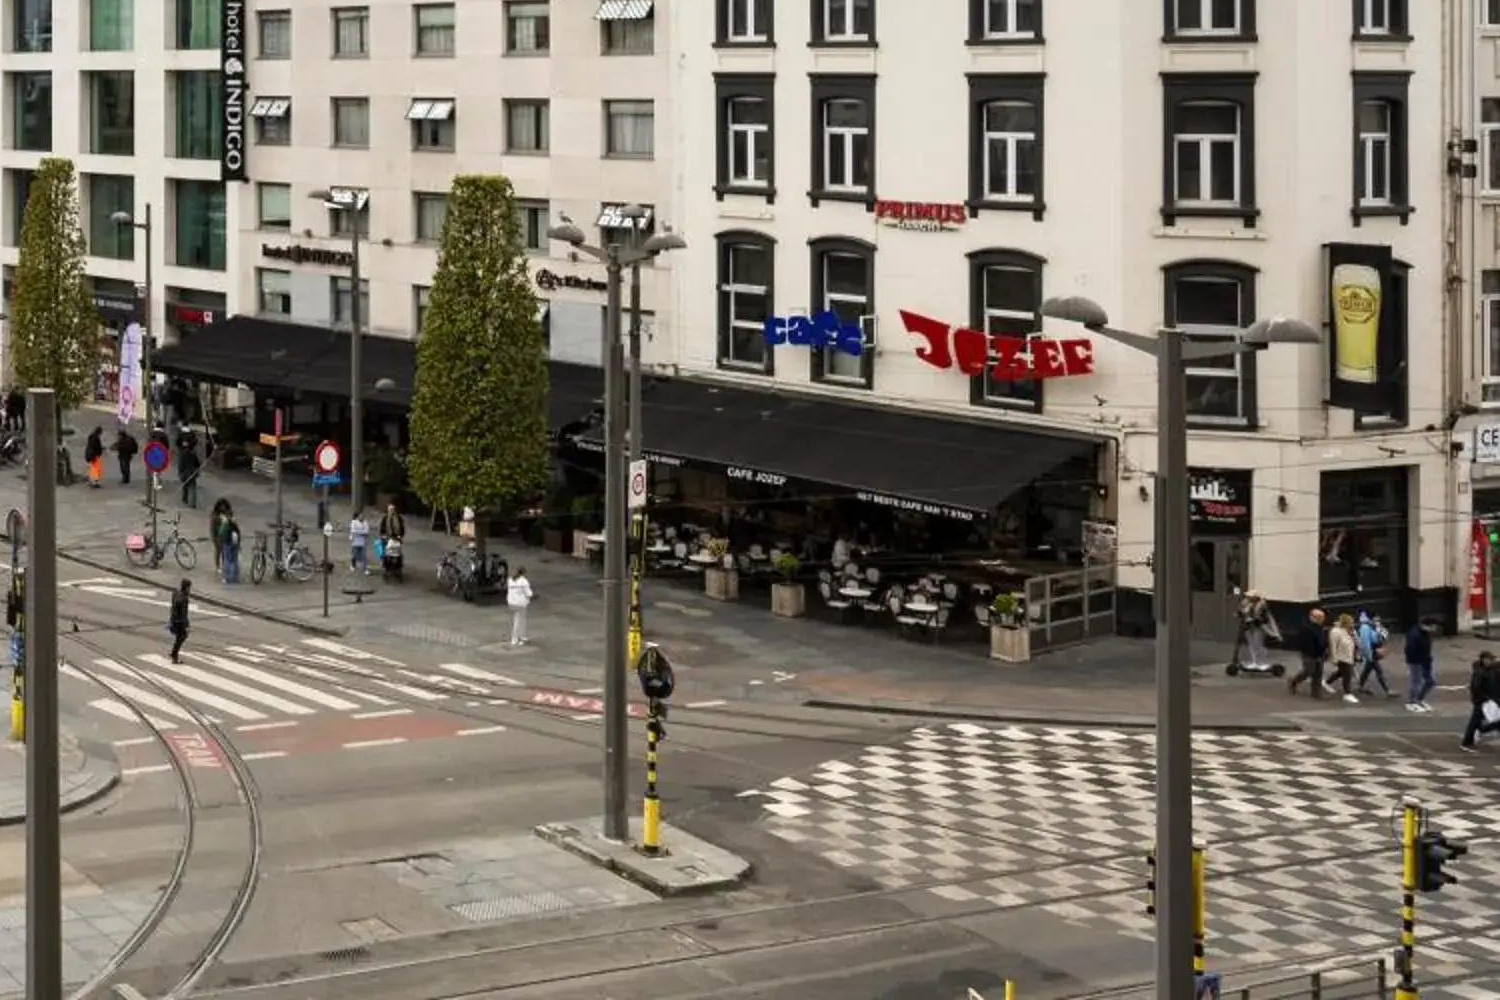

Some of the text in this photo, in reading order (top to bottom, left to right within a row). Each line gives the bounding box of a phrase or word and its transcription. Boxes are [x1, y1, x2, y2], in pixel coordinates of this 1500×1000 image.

[225, 2, 243, 171] hotel INDIGO
[874, 200, 967, 225] PRIMUS
[898, 309, 1095, 381] JOZEF
